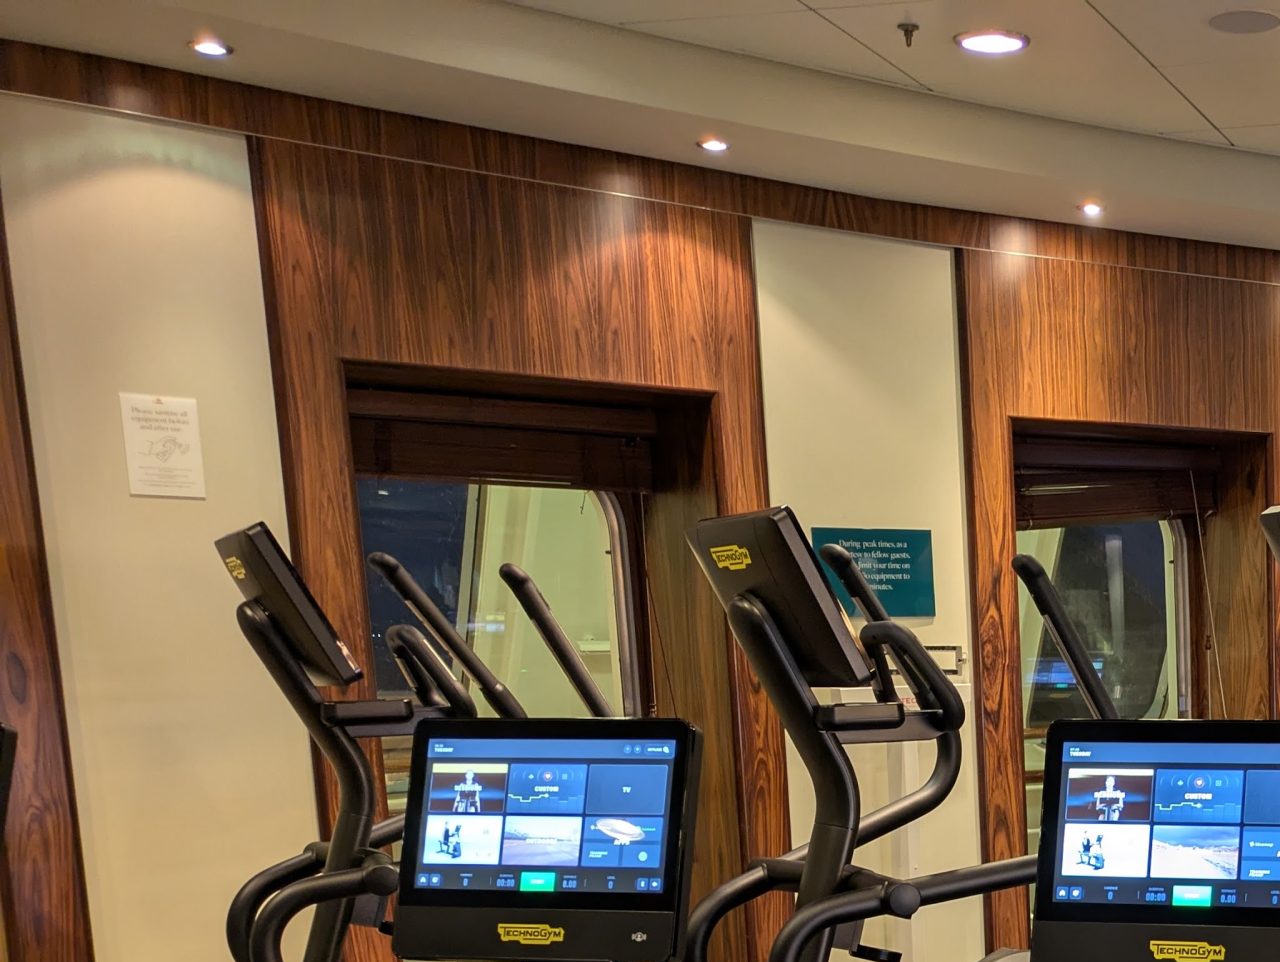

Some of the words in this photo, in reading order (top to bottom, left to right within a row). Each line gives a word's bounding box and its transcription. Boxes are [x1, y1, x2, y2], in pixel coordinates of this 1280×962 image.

[839, 540, 860, 550] During
[862, 540, 877, 549] peak
[871, 550, 889, 559] fellow
[873, 562, 886, 571] your
[870, 572, 903, 582] equipment
[1145, 892, 1167, 901] 00:00
[1220, 894, 1236, 903] 0.00
[499, 926, 561, 940] TECHNOGYM
[1152, 943, 1222, 959] TECHNOGYM
